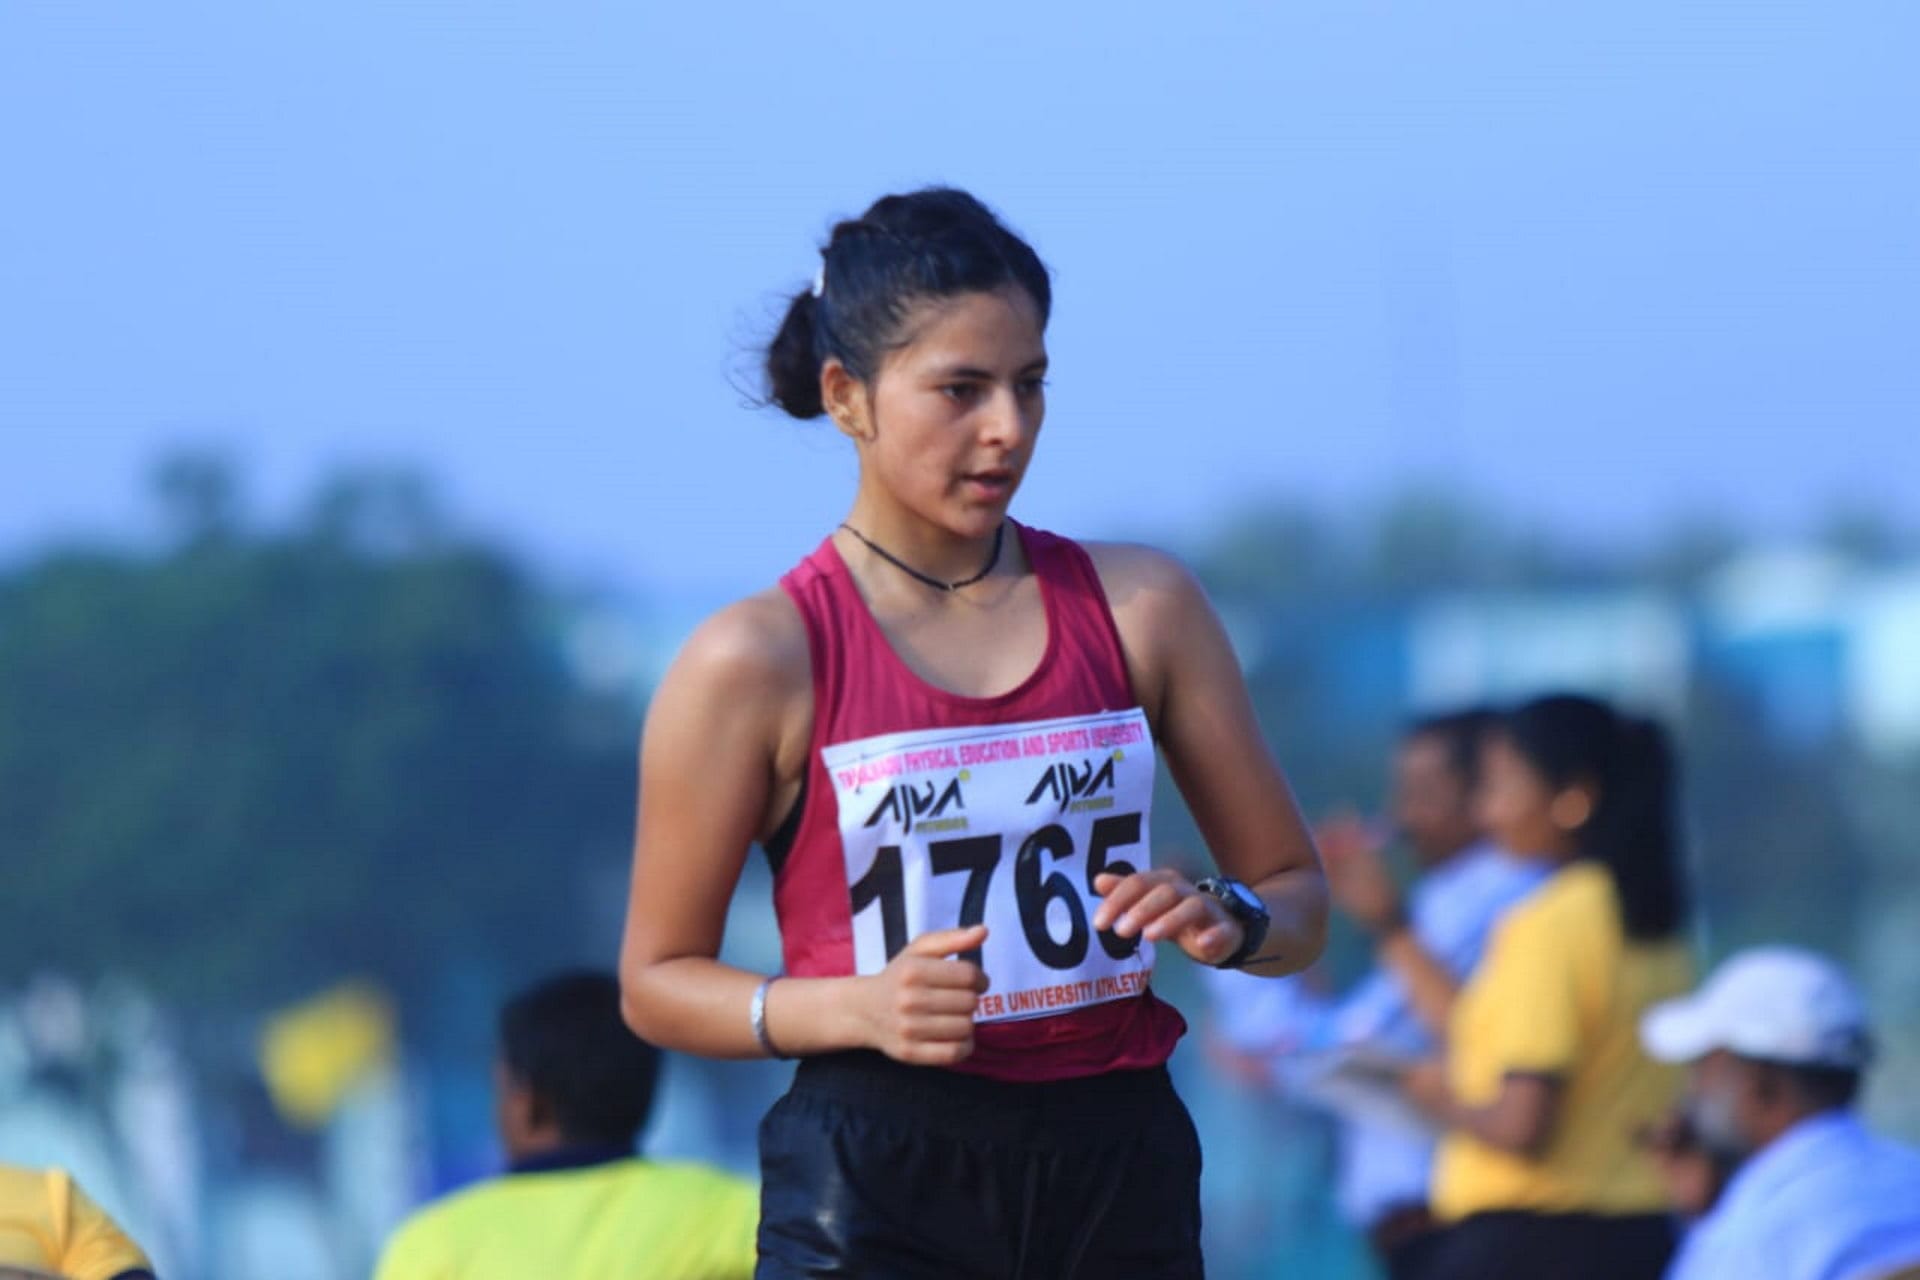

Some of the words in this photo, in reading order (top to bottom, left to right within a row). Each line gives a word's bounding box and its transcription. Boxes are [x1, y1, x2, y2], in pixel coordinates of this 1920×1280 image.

[904, 747, 959, 772] PHYSICAL
[959, 738, 1020, 766] EDUCATION
[1023, 734, 1046, 756] AND
[1048, 728, 1090, 753] SPORTS
[851, 812, 1142, 972] 1765
[1007, 980, 1093, 1012] UNIVERSITY
